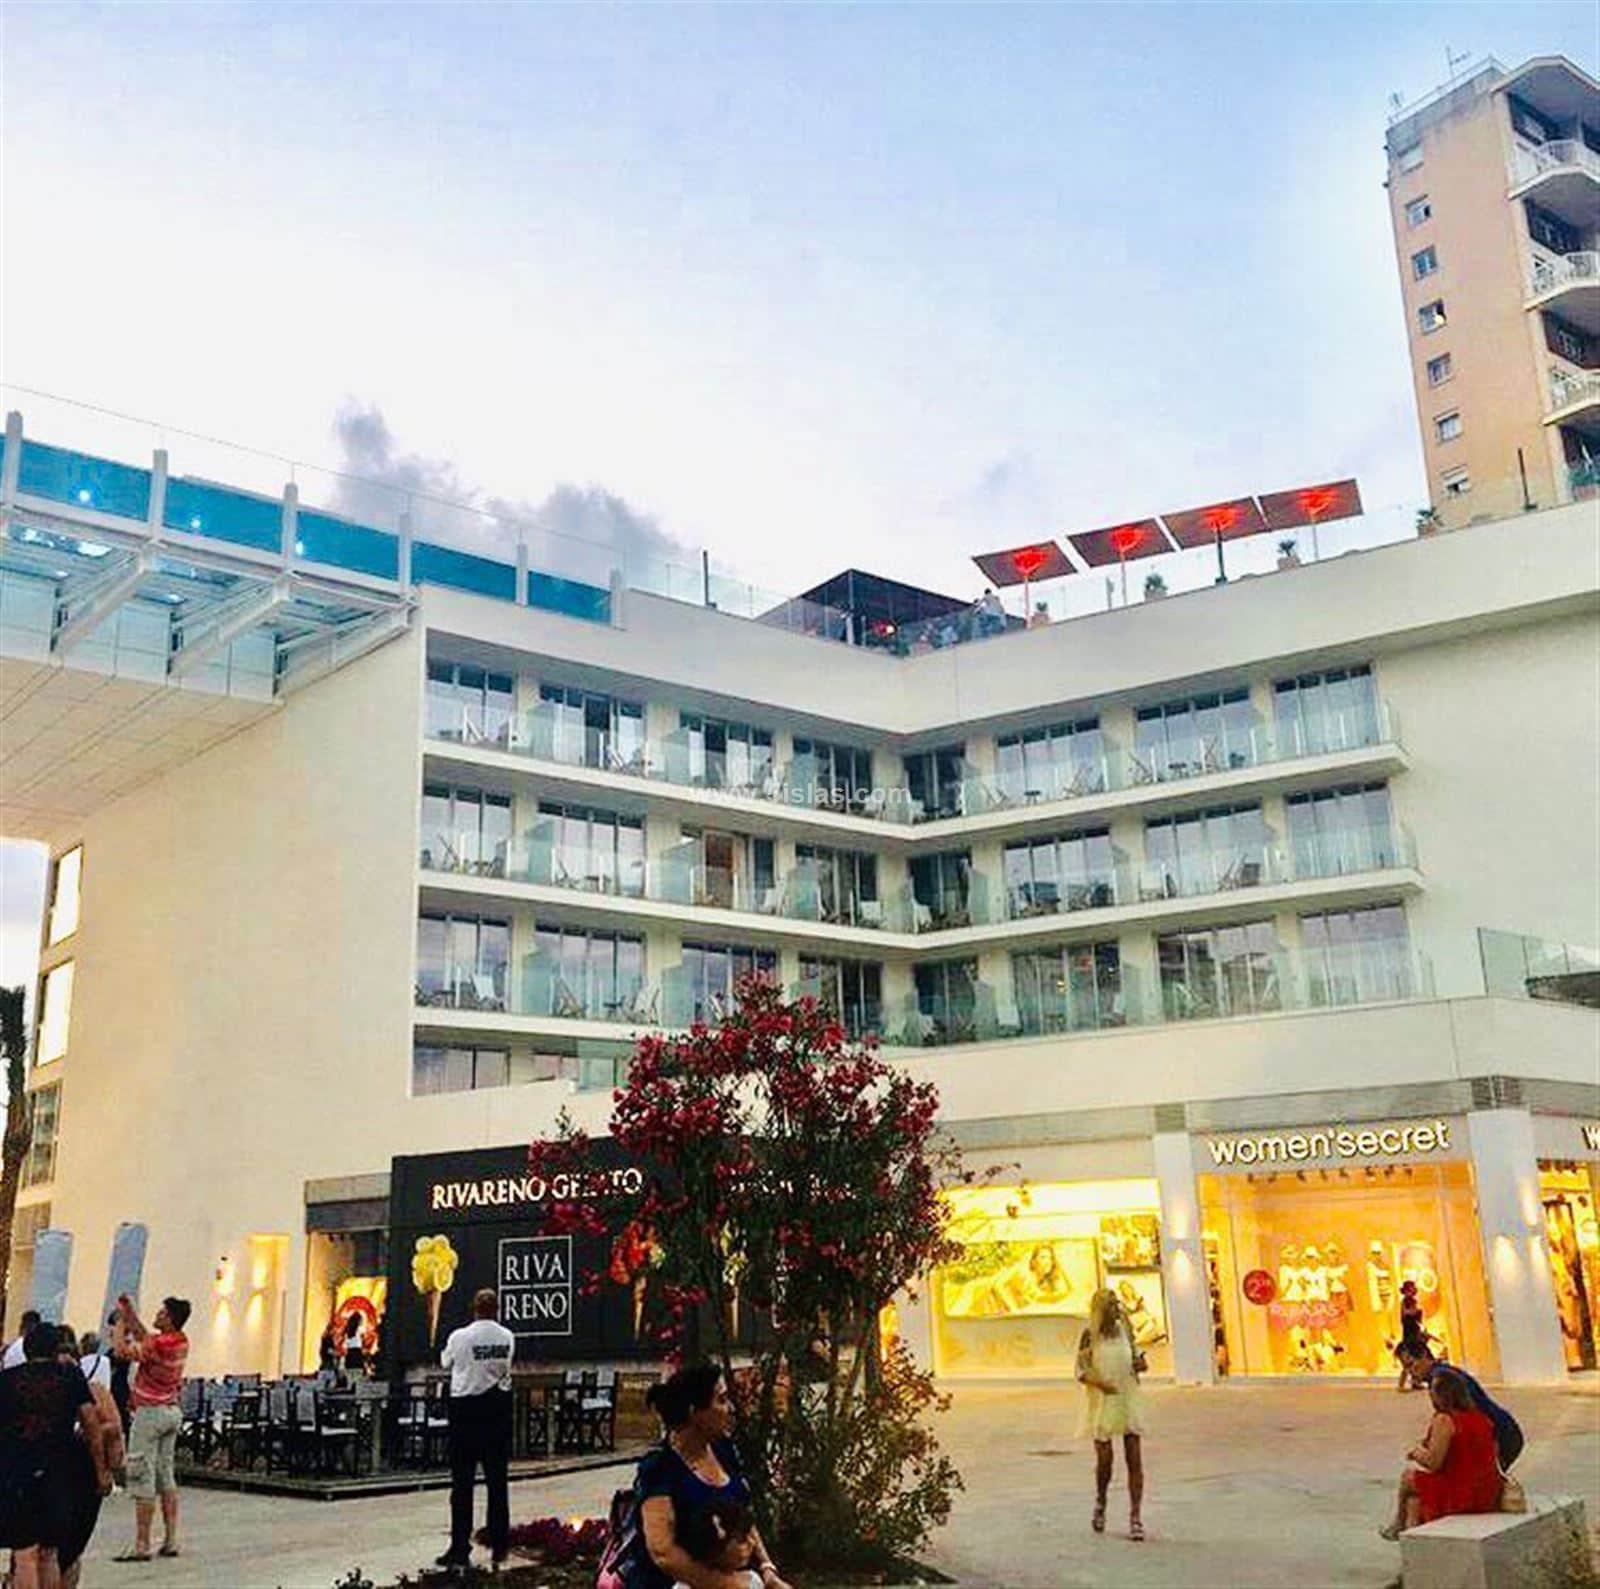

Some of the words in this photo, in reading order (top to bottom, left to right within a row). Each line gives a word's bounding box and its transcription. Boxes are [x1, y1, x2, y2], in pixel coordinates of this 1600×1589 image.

[1208, 1120, 1450, 1164] women'secret
[431, 1175, 546, 1210] RIVARENO
[505, 1253, 566, 1281] RIVA
[504, 1291, 568, 1321] RENO
